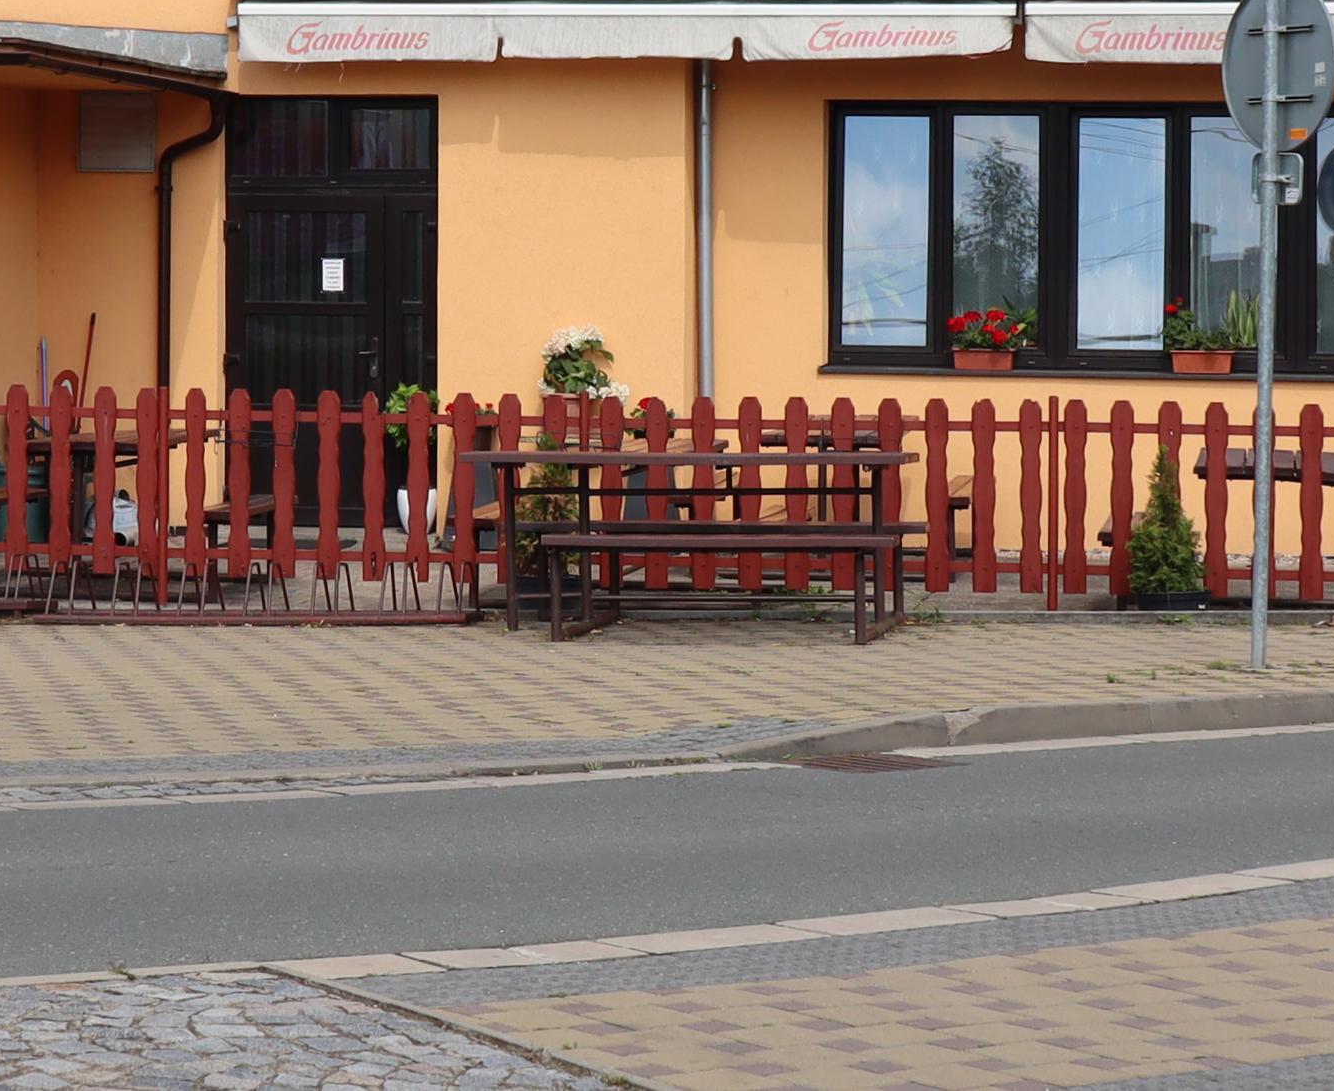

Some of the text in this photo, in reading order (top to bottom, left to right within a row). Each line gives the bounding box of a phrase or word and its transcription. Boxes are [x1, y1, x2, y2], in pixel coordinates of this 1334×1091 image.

[285, 20, 431, 55] Gambrinus
[807, 20, 958, 52] Gambrinus
[1075, 20, 1228, 55] Gambrinus
